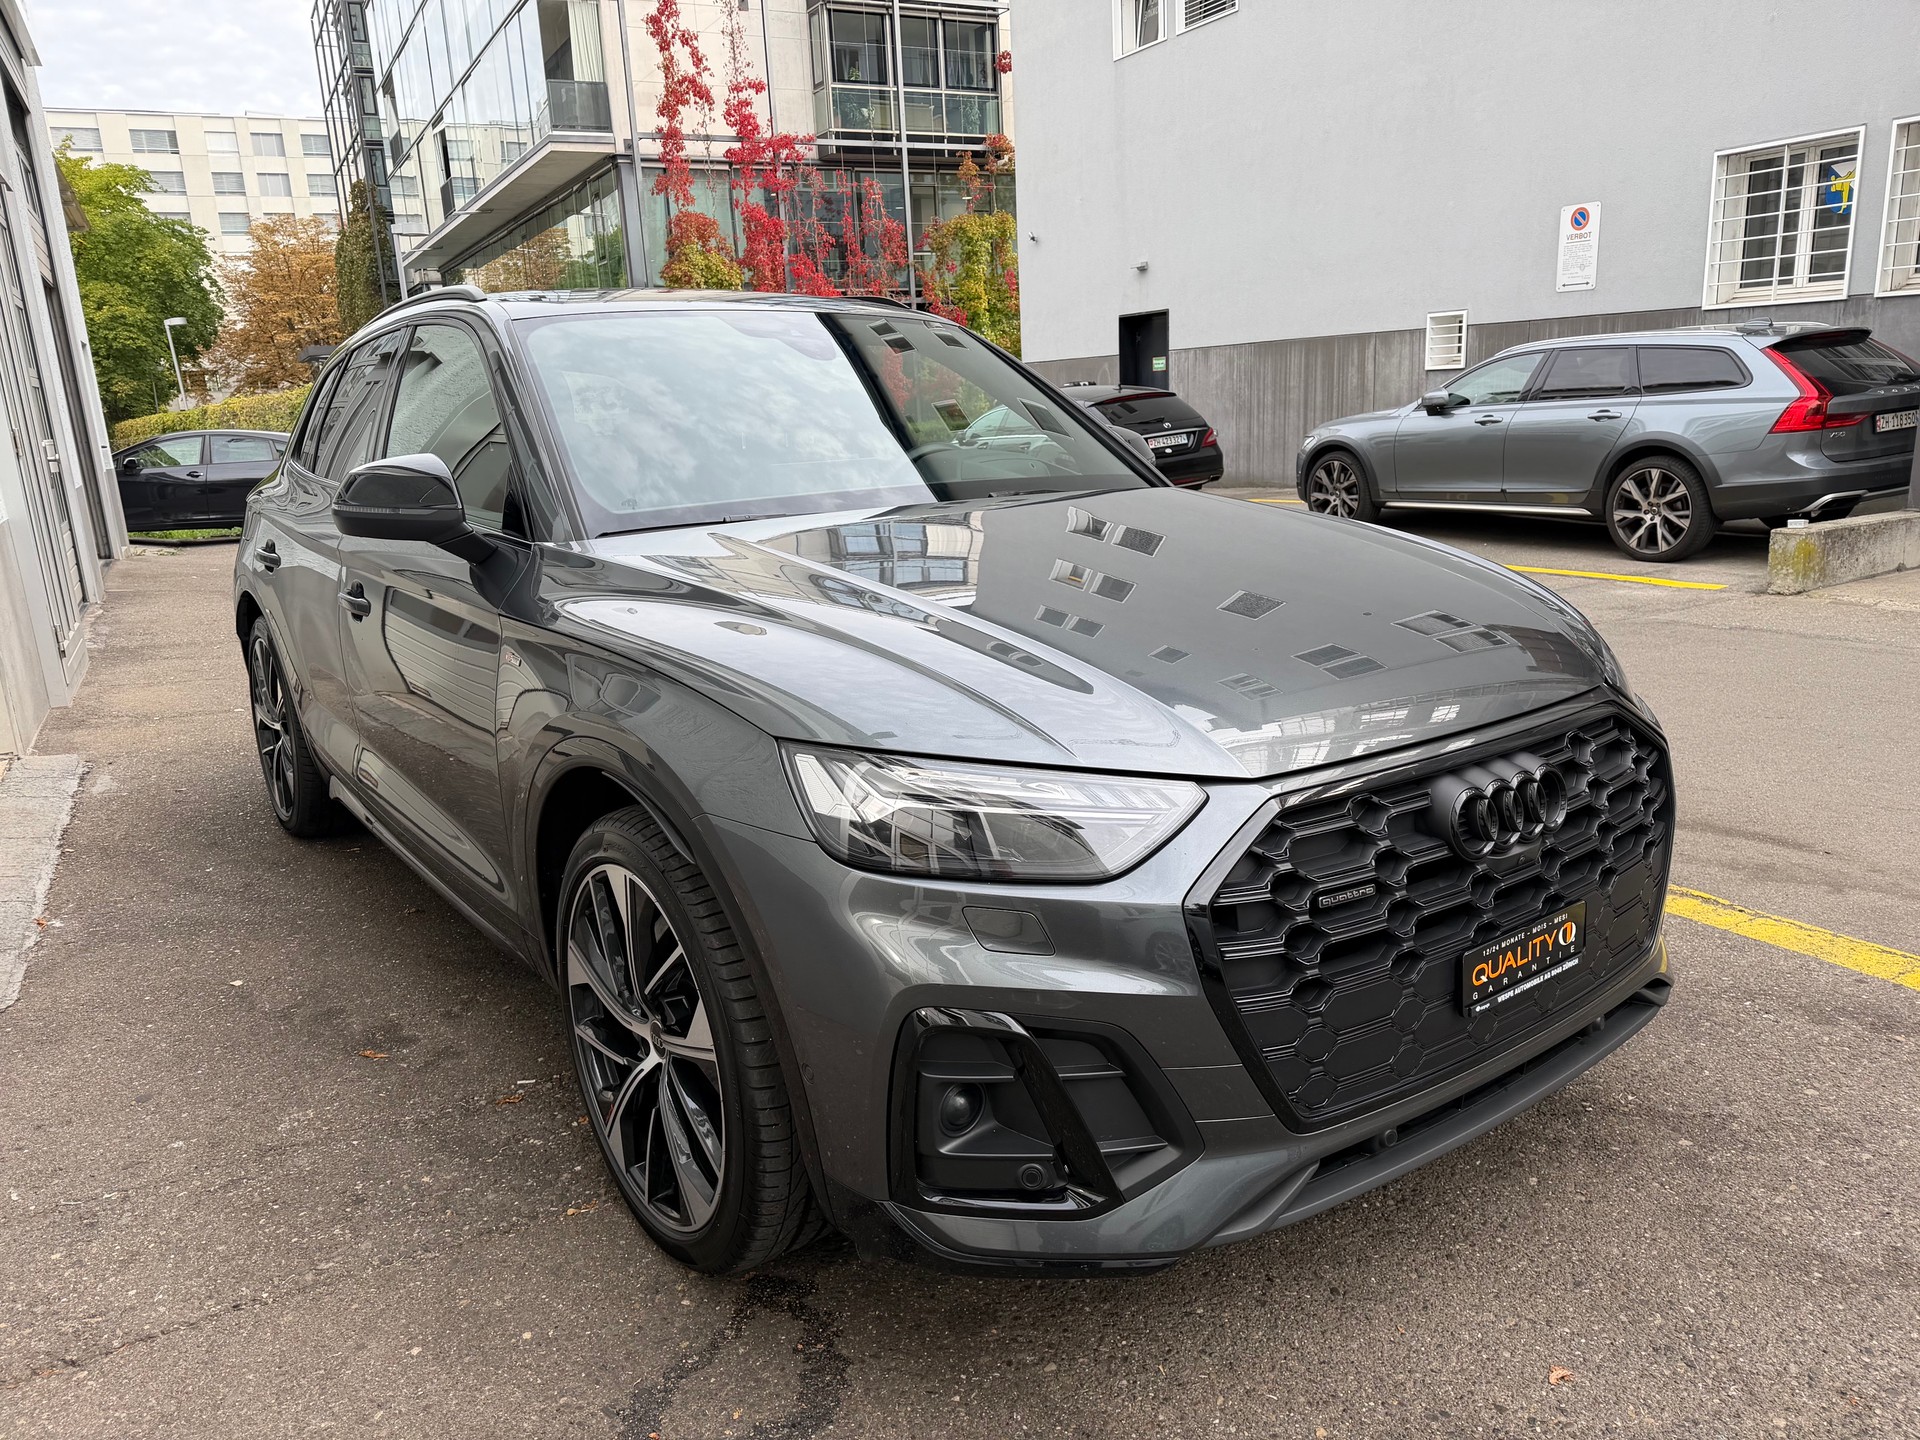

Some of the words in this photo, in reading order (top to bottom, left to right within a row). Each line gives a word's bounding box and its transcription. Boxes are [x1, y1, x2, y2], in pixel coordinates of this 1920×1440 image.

[1566, 231, 1592, 241] VERBOT
[1322, 887, 1374, 906] quattro
[1482, 944, 1499, 957] 12/24
[1501, 933, 1525, 948] MONATE
[1532, 922, 1547, 934] MOIS
[1554, 913, 1568, 924] MESI
[1472, 929, 1558, 986] QUALITY
